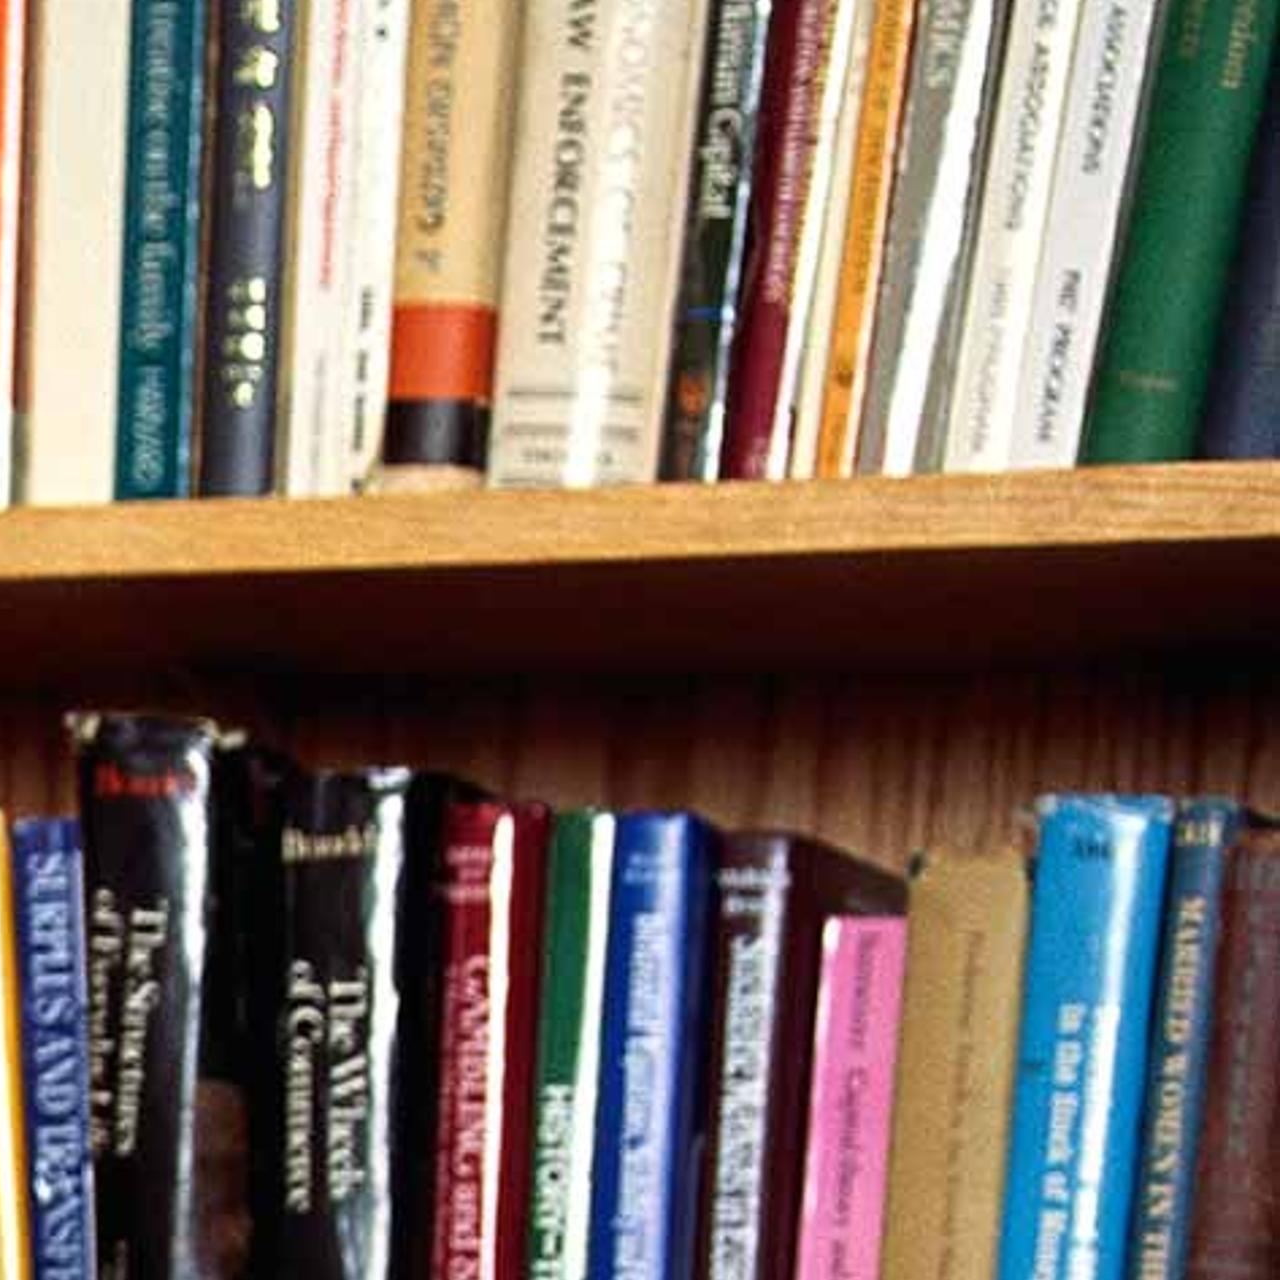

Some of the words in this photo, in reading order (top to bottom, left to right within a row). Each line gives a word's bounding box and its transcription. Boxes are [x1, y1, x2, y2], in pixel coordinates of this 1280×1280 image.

[1002, 42, 1051, 231] ASSOCIATIONS
[1081, 3, 1127, 176] ASSOCIATIONS
[537, 72, 594, 346] ENFORCEMENT
[697, 107, 743, 220] Capital
[1038, 323, 1072, 444] PROGRAM
[24, 850, 78, 1026] SURPLUS
[91, 889, 120, 927] of
[126, 901, 170, 975] The
[286, 958, 320, 1000] of
[329, 970, 369, 1057] The
[1162, 895, 1207, 1044] MARRIED
[32, 1032, 80, 1116] AND
[116, 977, 162, 1157] Structures
[284, 1005, 319, 1215] Commerce
[453, 953, 494, 1178] GAMBLING
[1054, 1040, 1085, 1084] the
[1150, 1050, 1188, 1175] WOMEN
[326, 1058, 368, 1201] Wheels
[1044, 1090, 1080, 1164] Stock
[1044, 1171, 1072, 1200] of
[448, 1183, 482, 1250] and
[1144, 1182, 1175, 1222] IN
